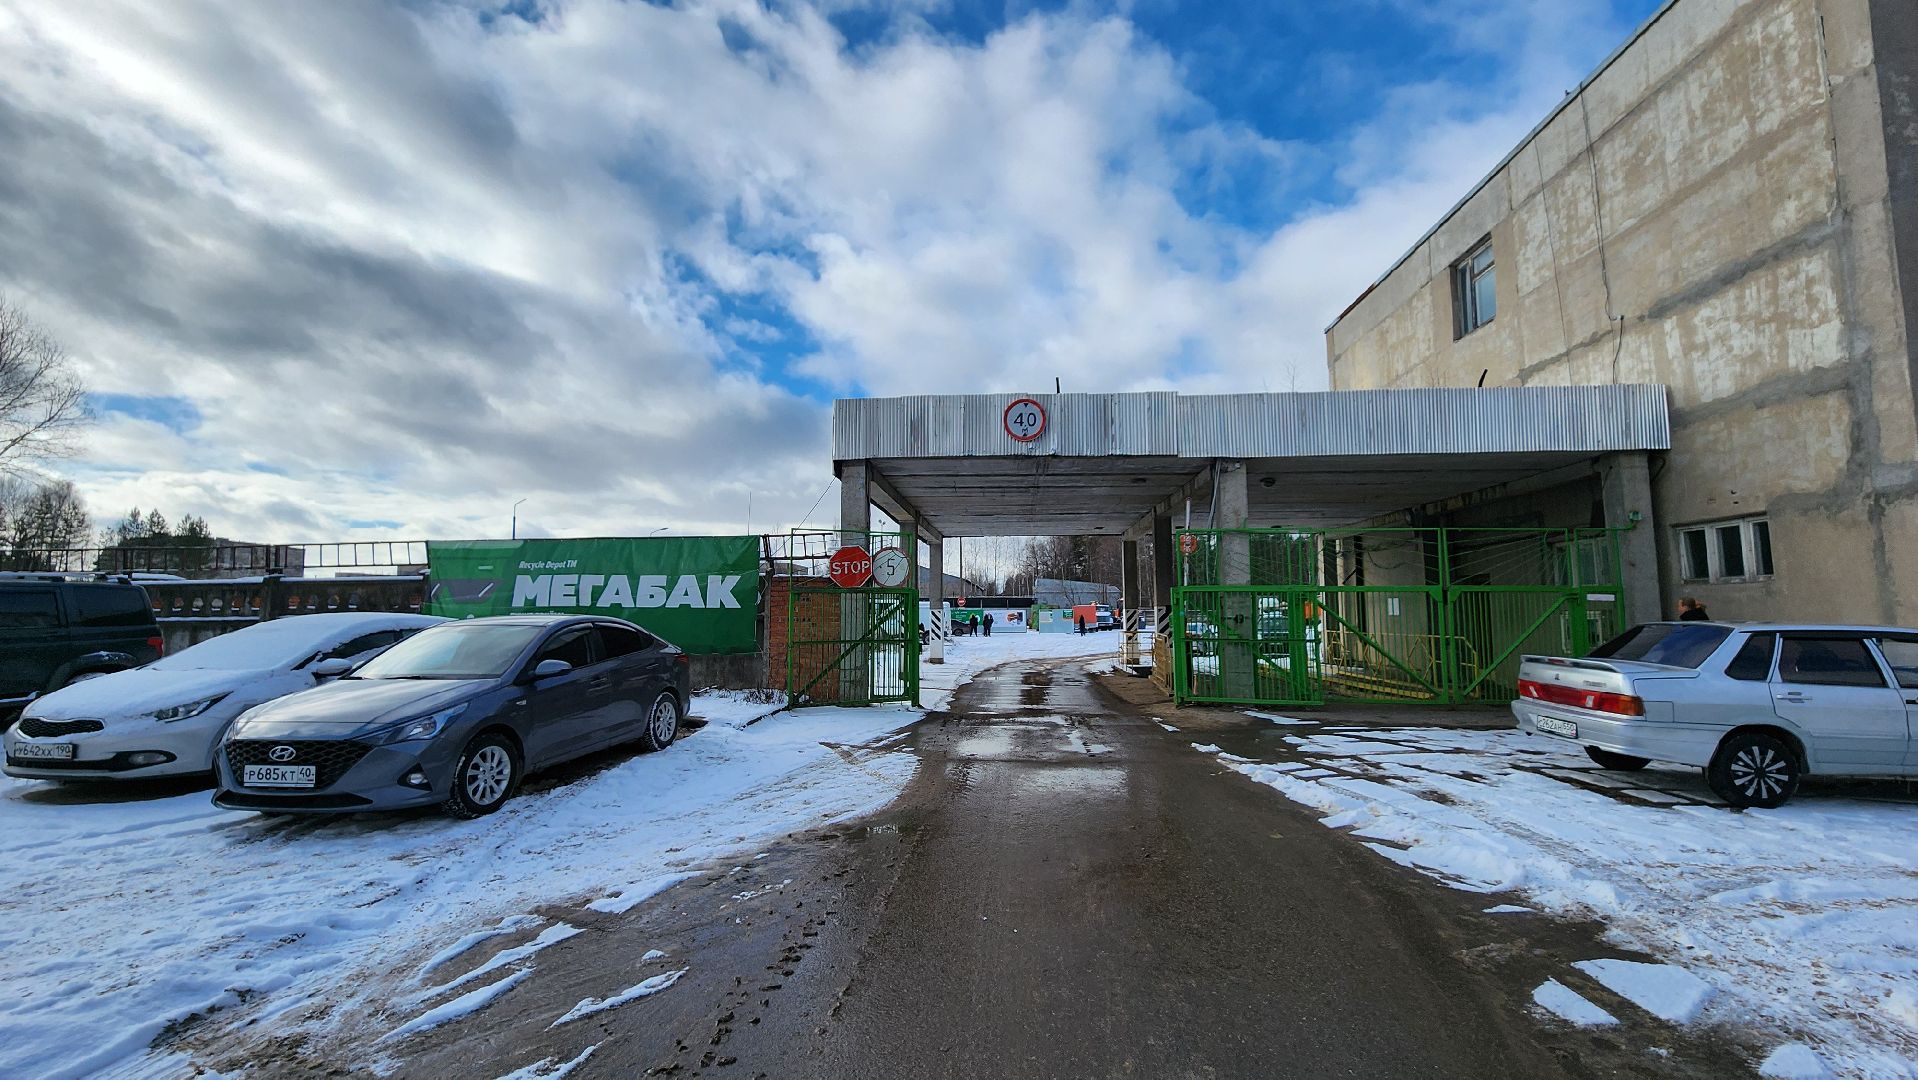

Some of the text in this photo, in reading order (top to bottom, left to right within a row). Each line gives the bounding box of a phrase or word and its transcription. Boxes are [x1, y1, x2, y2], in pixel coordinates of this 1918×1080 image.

[518, 559, 578, 571] Recycle Depot TM
[832, 560, 870, 575] STOP
[886, 559, 895, 576] 5
[511, 574, 742, 609] МЕГАБАК
